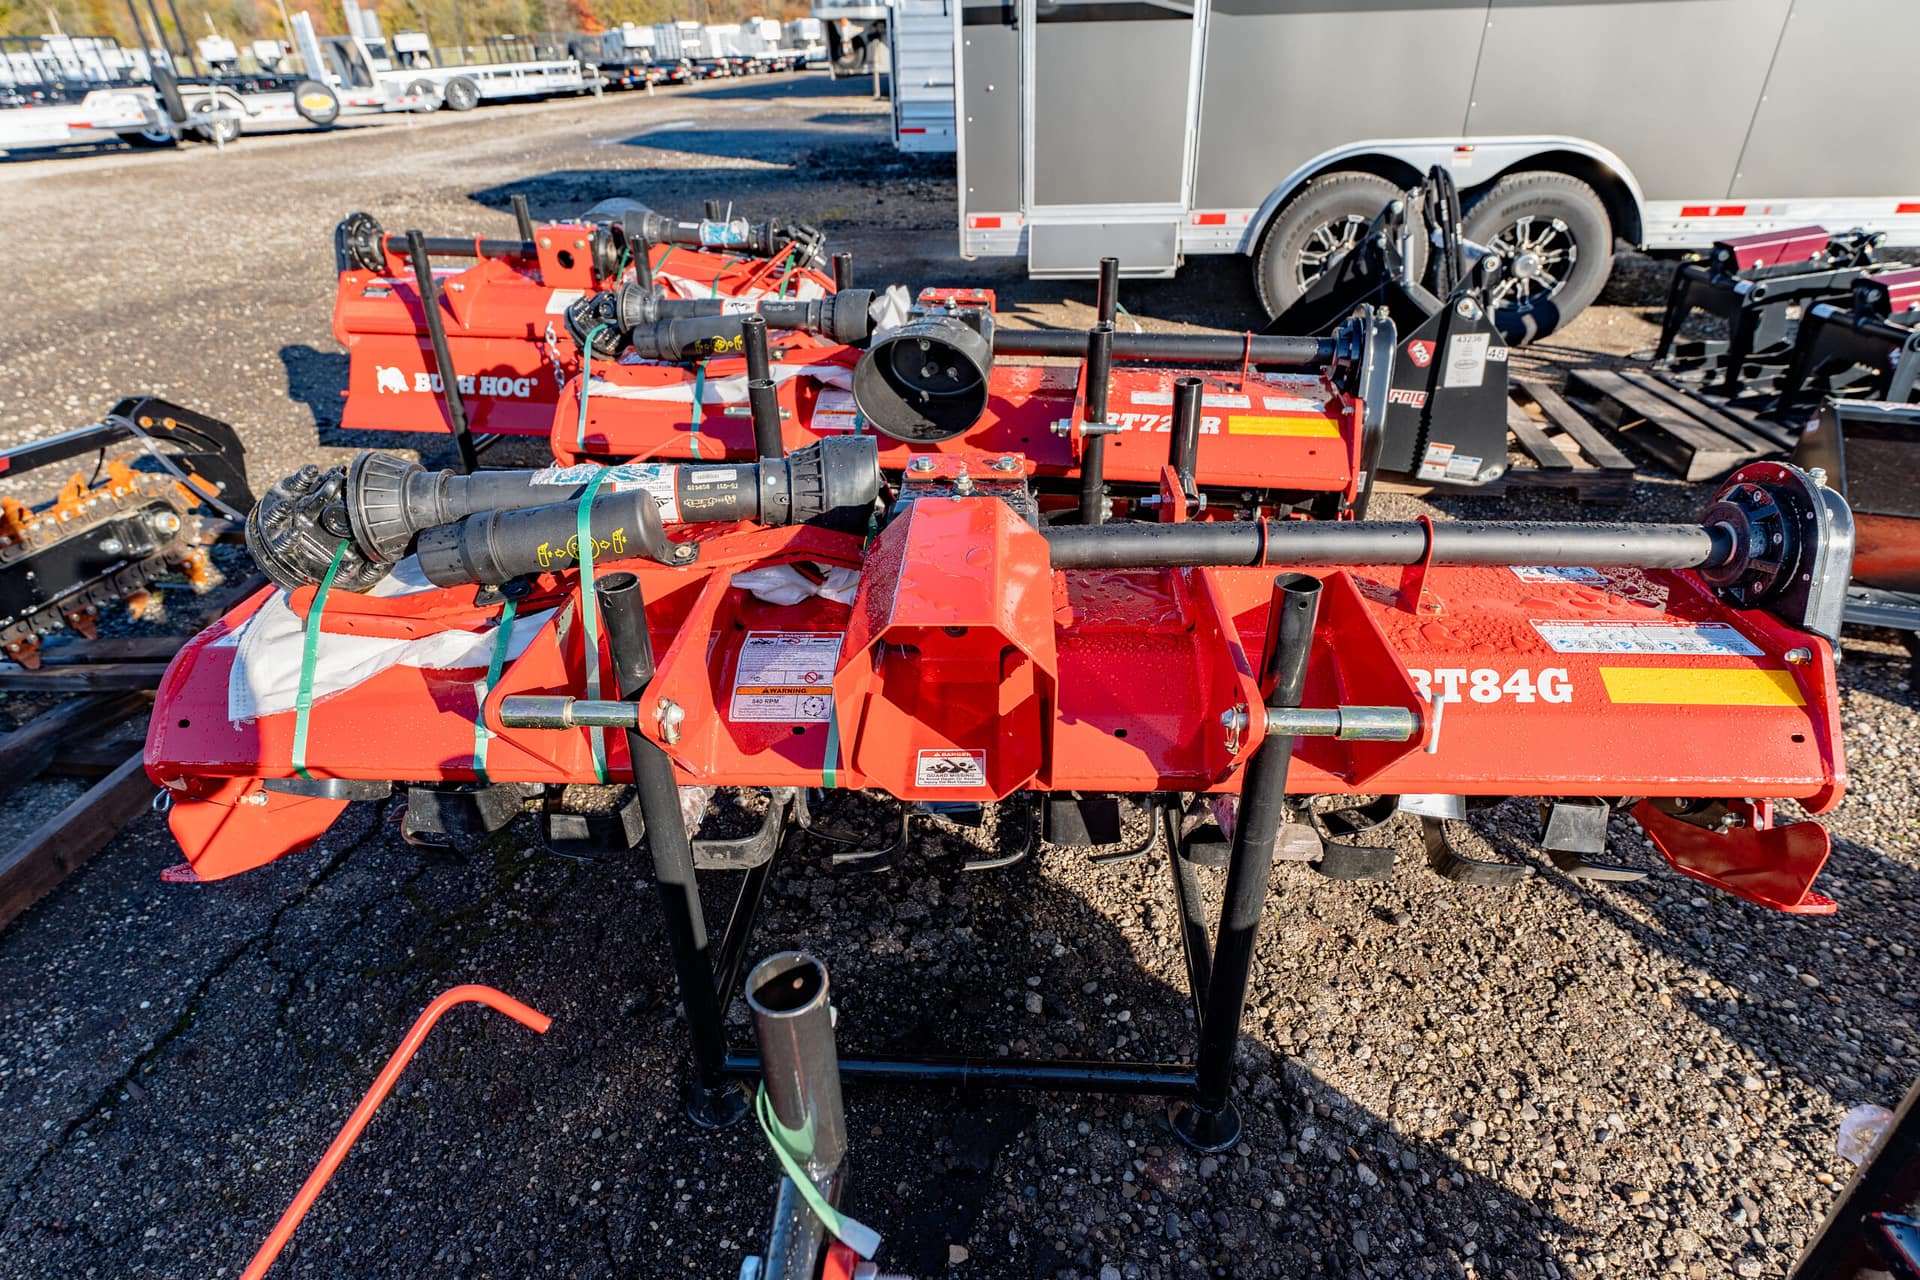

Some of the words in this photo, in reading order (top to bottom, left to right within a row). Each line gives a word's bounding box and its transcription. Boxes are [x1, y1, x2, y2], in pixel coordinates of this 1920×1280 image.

[1412, 342, 1430, 364] V20
[1488, 347, 1506, 359] 48
[414, 372, 476, 395] BUH
[1106, 412, 1222, 435] T72R
[1406, 667, 1574, 704] RT84G
